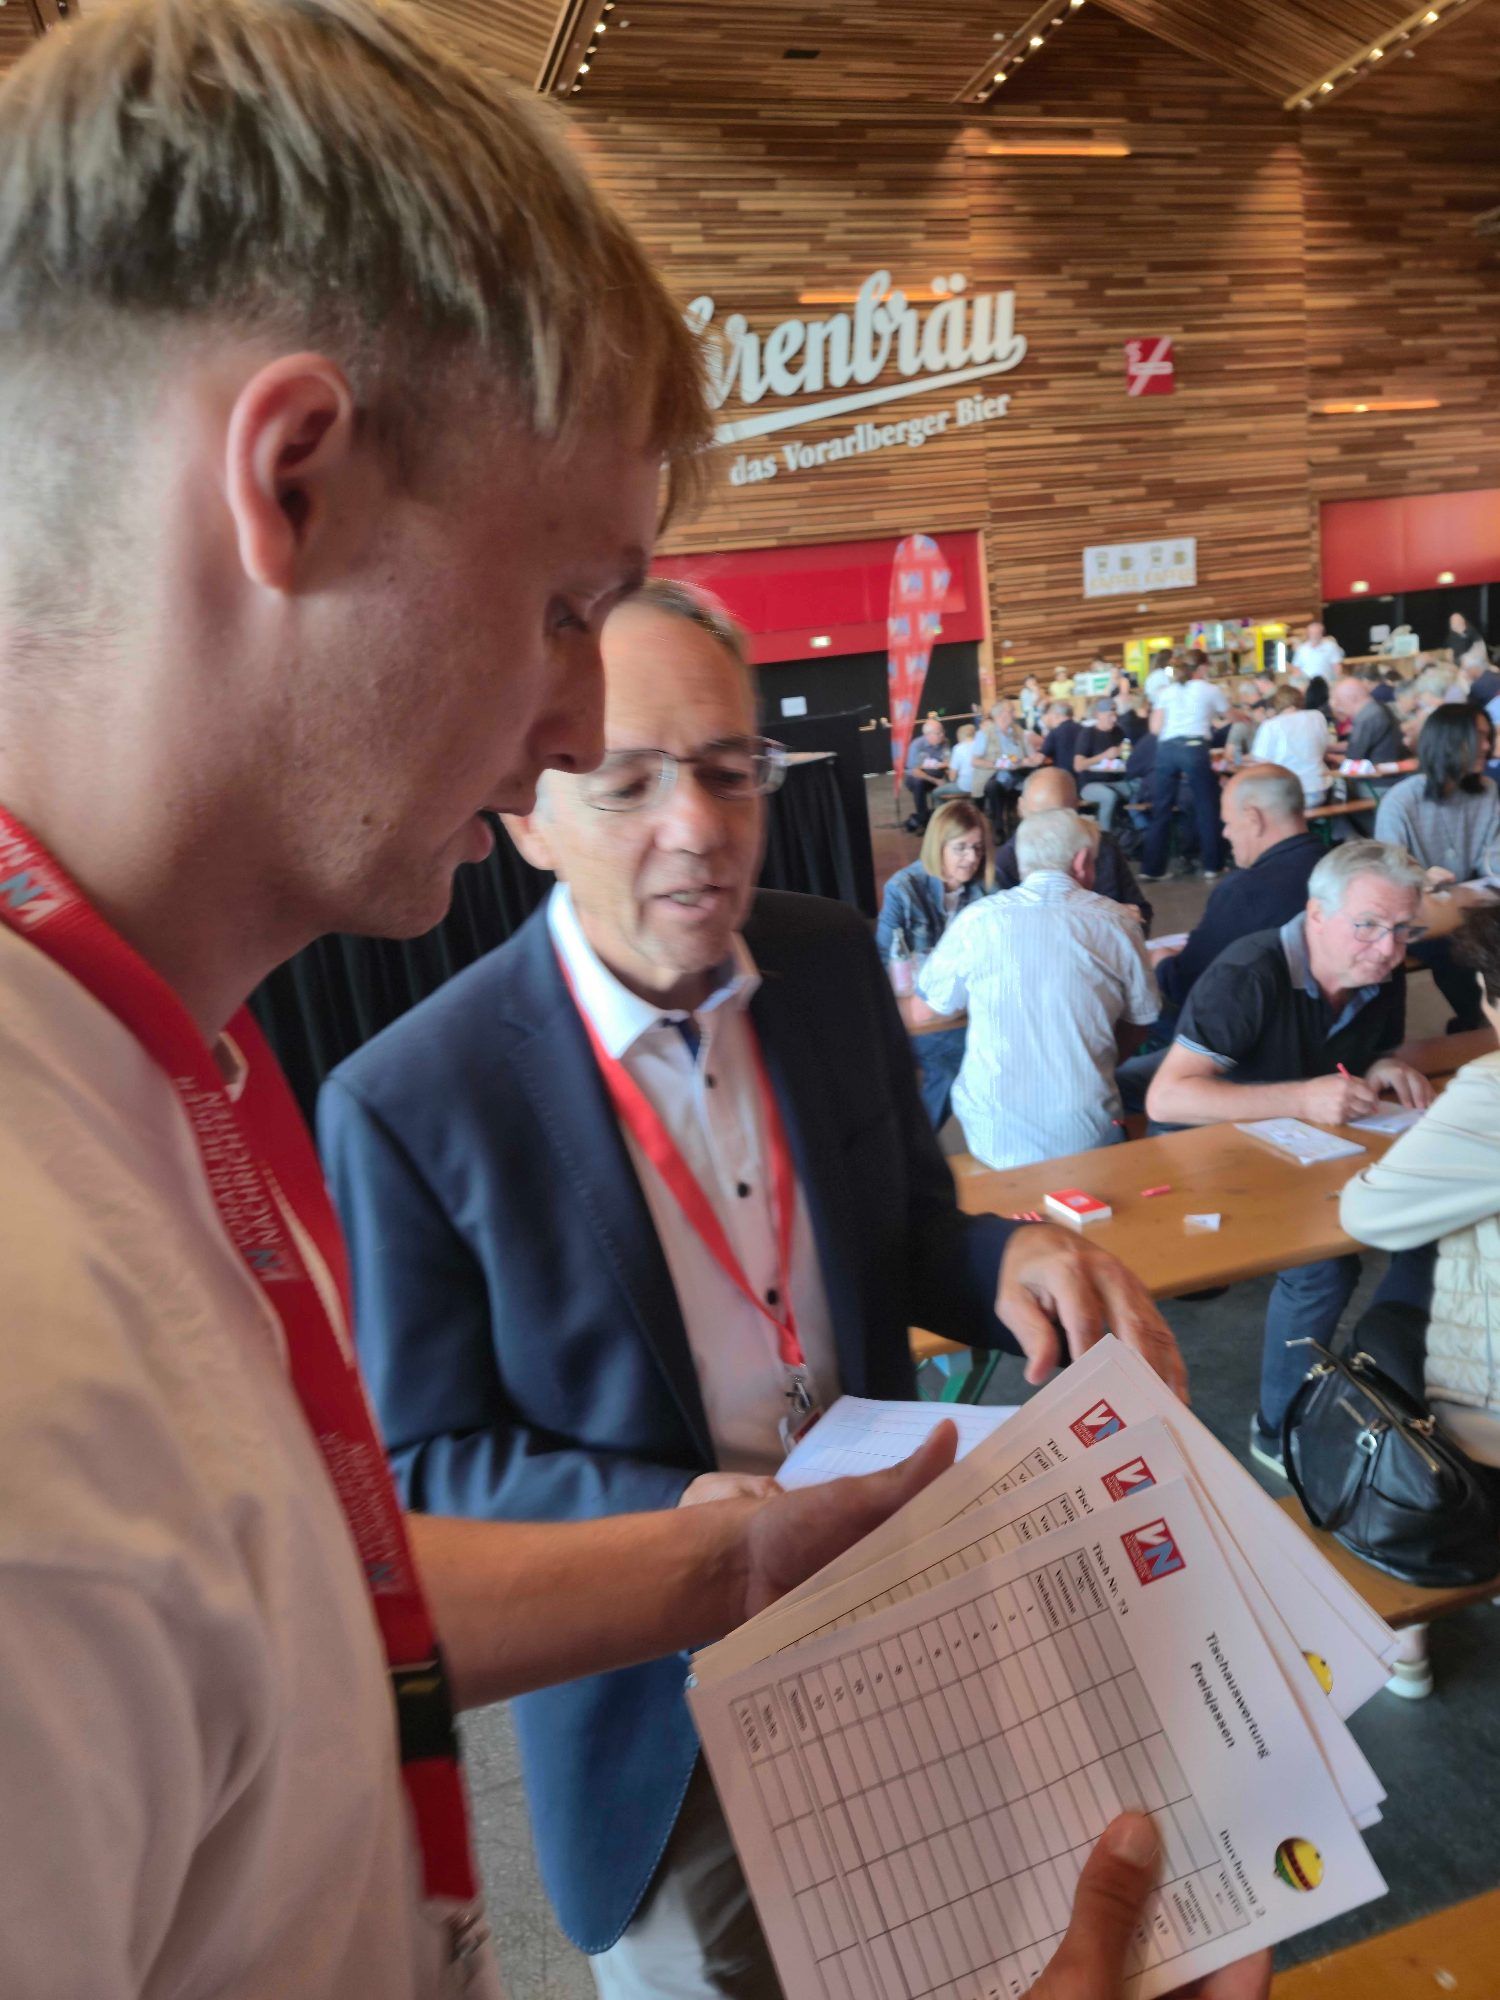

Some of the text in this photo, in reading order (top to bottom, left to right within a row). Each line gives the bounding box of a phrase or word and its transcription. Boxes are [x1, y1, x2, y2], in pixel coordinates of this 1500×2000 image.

[729, 393, 1012, 486] das Vorarlberger Bier
[1092, 1542, 1110, 1575] Tisch
[1135, 1522, 1182, 1577] VN
[1035, 1574, 1060, 1627] Nachname
[1056, 1569, 1076, 1614] Vorname
[1190, 1661, 1236, 1748] Preisjassen
[1206, 1631, 1271, 1759] Tischauswertung
[1219, 1829, 1258, 1905] Durchgang
